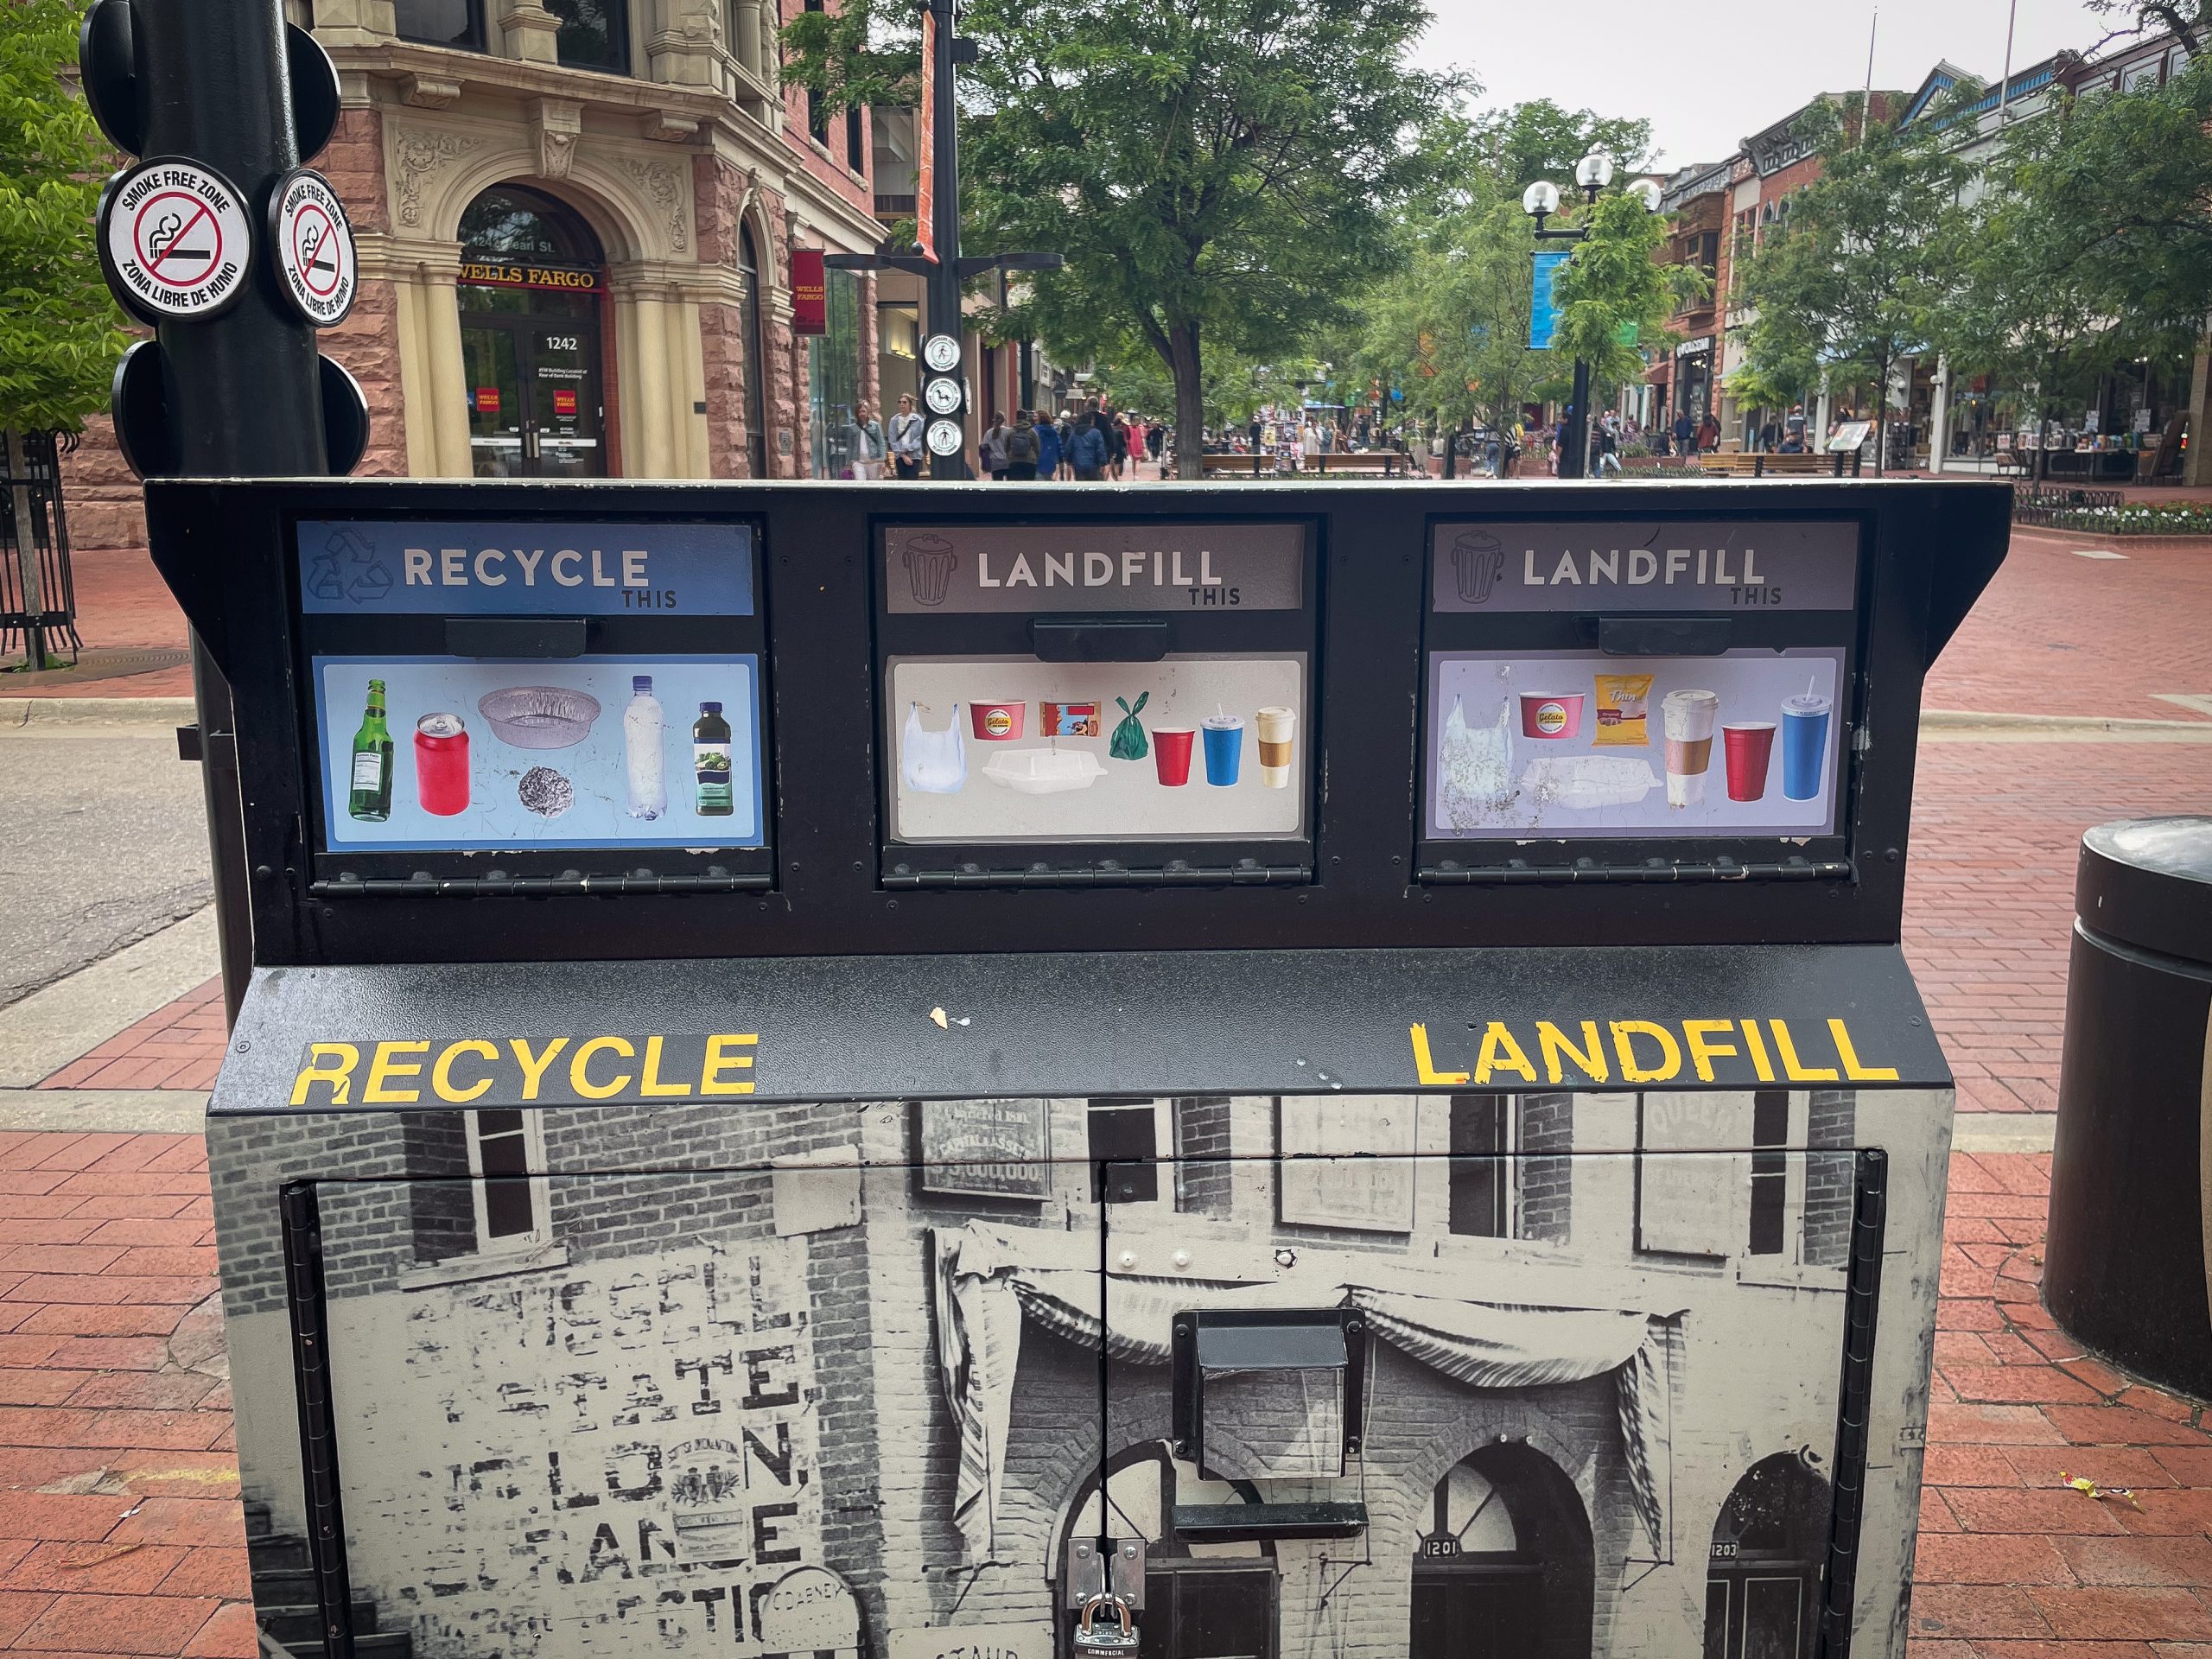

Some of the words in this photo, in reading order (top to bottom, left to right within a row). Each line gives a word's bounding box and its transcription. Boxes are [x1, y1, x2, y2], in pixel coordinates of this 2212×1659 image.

[122, 173, 162, 212] SMOKE
[163, 171, 197, 190] FREE
[197, 180, 230, 214] ZONE
[285, 184, 307, 218] SMOKE
[307, 184, 325, 207] FREE
[325, 198, 343, 232] ZONE
[122, 258, 152, 295] ZONA
[151, 285, 189, 307] LIBRE
[190, 290, 209, 307] DE
[207, 262, 238, 299] HUMO
[288, 264, 304, 300] ZONA
[306, 293, 327, 315] LIBRE
[326, 299, 336, 315] DE
[334, 276, 349, 309] HUMO
[527, 269, 594, 288] FARGO
[546, 336, 578, 351] 1242
[404, 548, 650, 587] RECYCLE
[978, 550, 1223, 588] LANDFILL
[1523, 549, 1764, 585] LANDFILL
[621, 589, 677, 609] THIS
[1188, 588, 1241, 606] THIS
[1731, 587, 1783, 606] THIS
[1539, 713, 1563, 722] Gelato
[288, 1033, 759, 1105] RECYCLE
[1410, 1018, 1900, 1085] LANDFILL
[548, 1421, 810, 1511] LON,
[1427, 1541, 1456, 1555] 1201
[1712, 1544, 1737, 1556] 1203
[1087, 1648, 1125, 1656] COMMERCIAL
